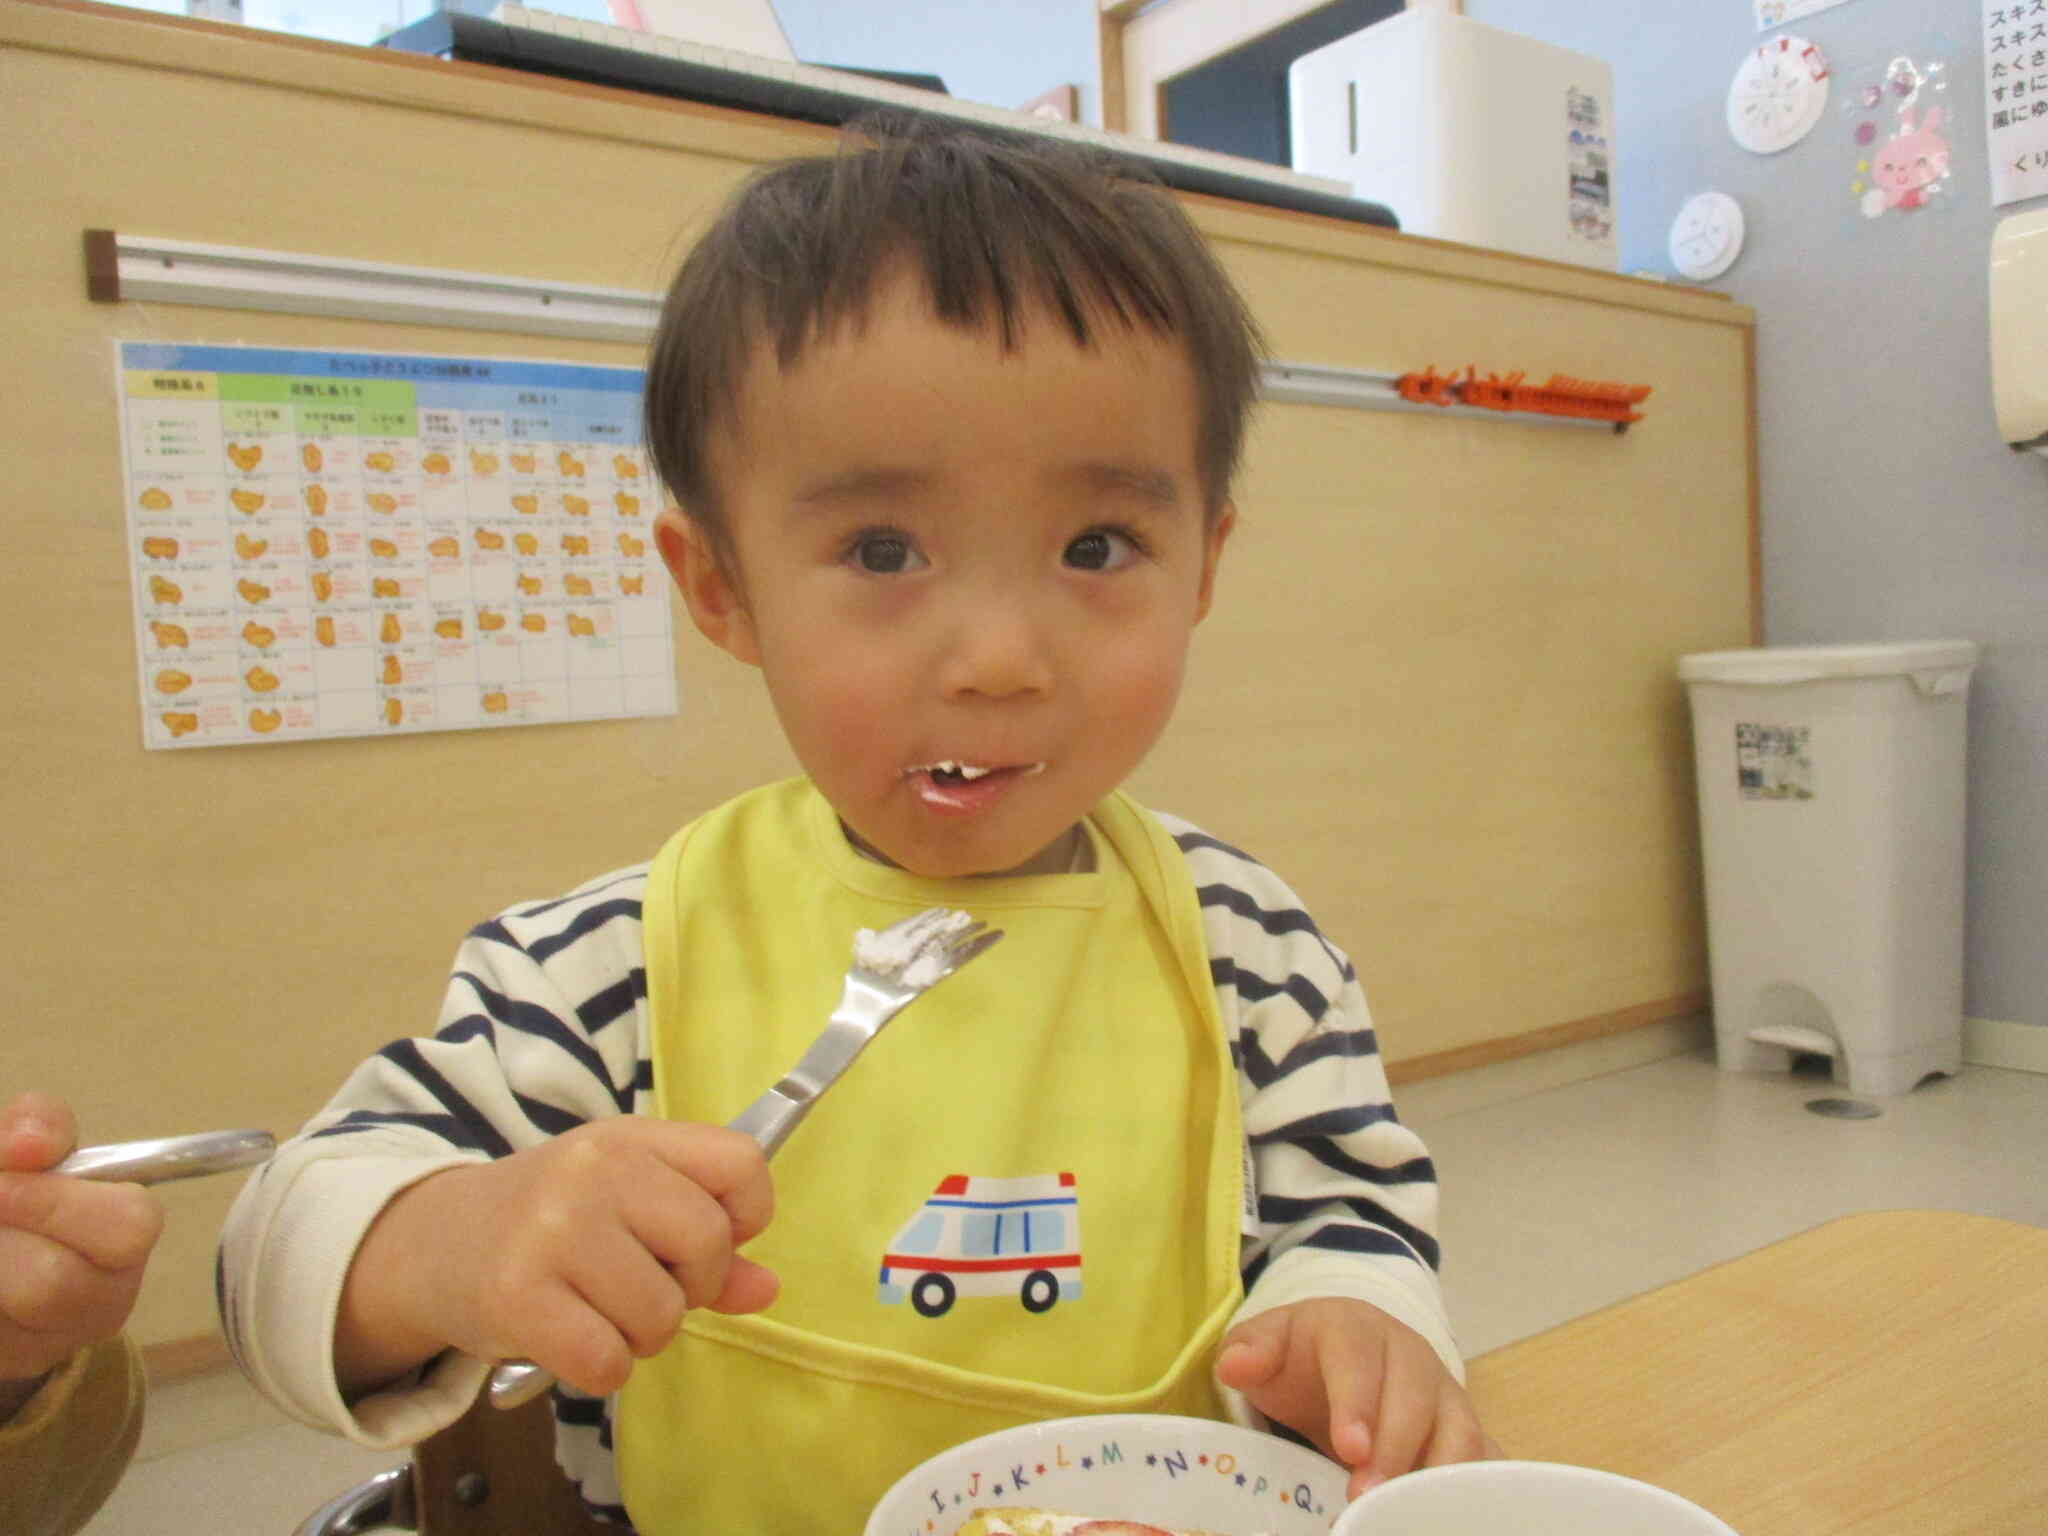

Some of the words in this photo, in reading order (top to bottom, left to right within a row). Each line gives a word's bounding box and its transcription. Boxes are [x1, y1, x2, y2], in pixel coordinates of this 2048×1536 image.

[930, 1489, 946, 1514] I
[968, 1471, 982, 1497] J
[1010, 1464, 1031, 1491] K
[1056, 1443, 1073, 1468] L
[1101, 1440, 1124, 1465] M
[1163, 1449, 1189, 1478] N
[1215, 1453, 1236, 1475] O
[1293, 1483, 1312, 1512] Q
